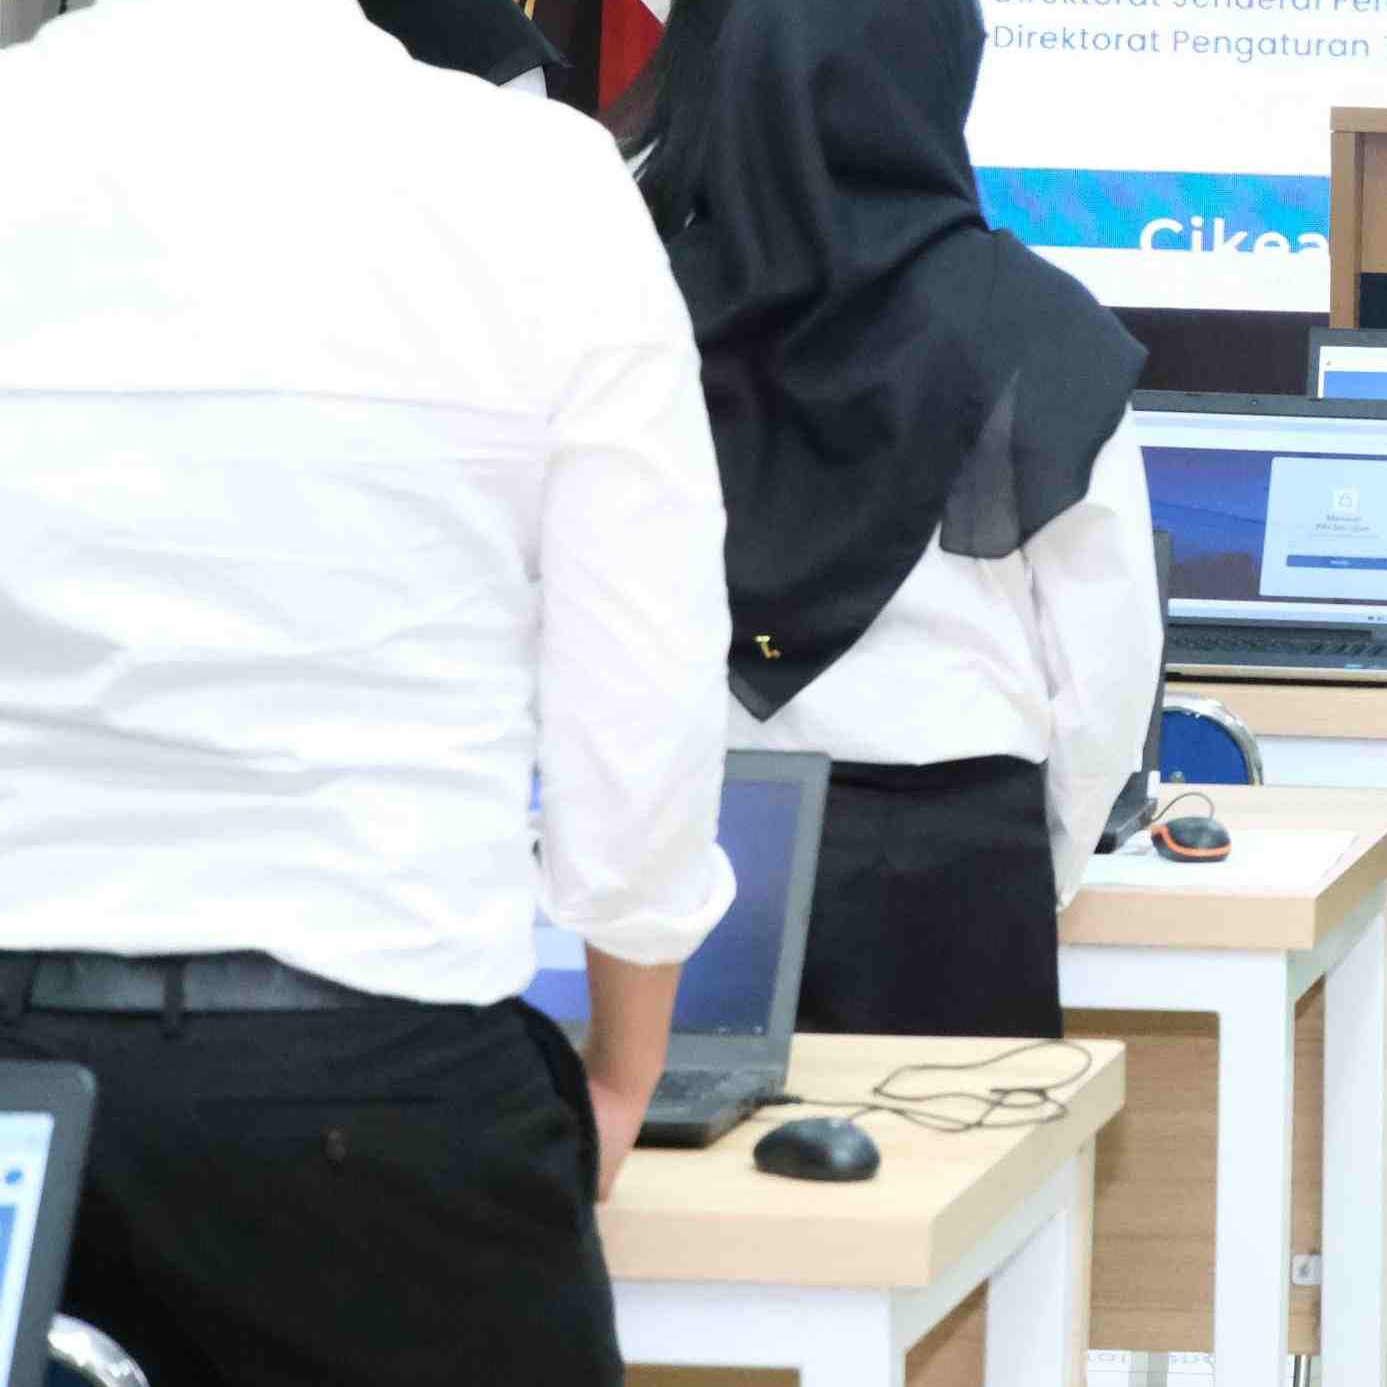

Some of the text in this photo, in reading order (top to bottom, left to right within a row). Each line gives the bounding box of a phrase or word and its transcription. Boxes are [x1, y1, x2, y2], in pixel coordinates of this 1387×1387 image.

[994, 24, 1162, 53] Direktorat
[1173, 29, 1369, 63] Pengaturan
[1140, 216, 1329, 253] Cikea
